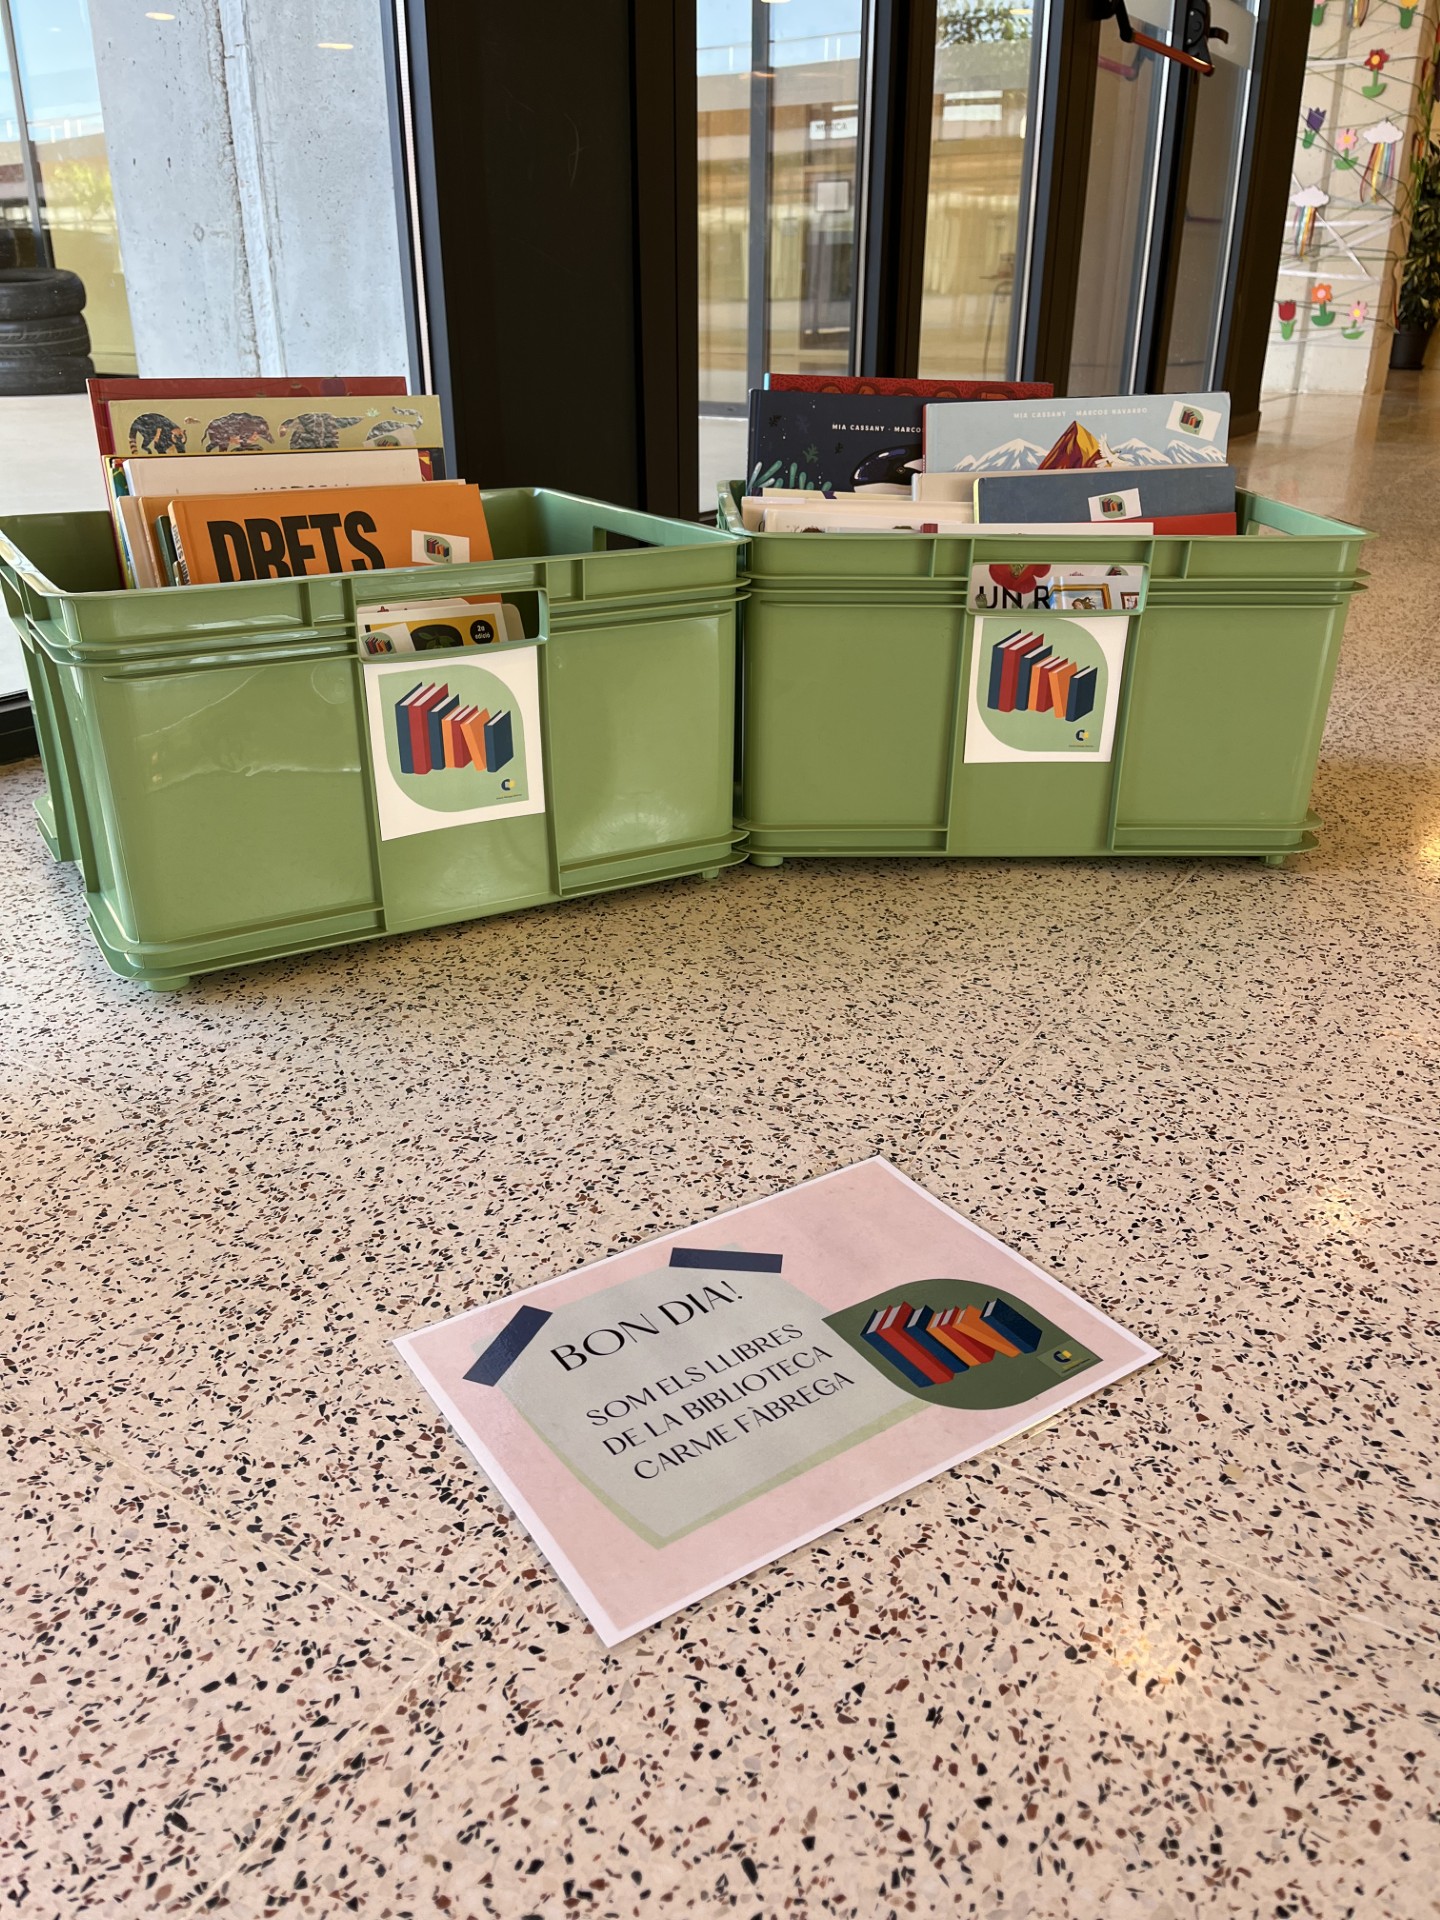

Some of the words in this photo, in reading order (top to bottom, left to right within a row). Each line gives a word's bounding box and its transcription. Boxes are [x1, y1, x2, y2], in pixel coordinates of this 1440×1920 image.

[831, 423, 847, 431] MIA
[849, 424, 885, 432] CASSANY
[1031, 410, 1066, 419] CASSANY
[1076, 409, 1108, 417] MARCOS
[1111, 407, 1148, 415] NAVARRO
[207, 511, 386, 583] DRETS
[550, 1313, 660, 1371] BON
[657, 1280, 743, 1326] DIA!
[586, 1387, 658, 1426] SOM
[655, 1366, 707, 1396] ELS
[704, 1324, 803, 1374] LLIBRES
[602, 1427, 647, 1456] DE
[643, 1412, 684, 1437] LA
[680, 1346, 834, 1420] BIBLIOTECA
[633, 1423, 738, 1479] CARME
[733, 1371, 855, 1433] FÀBREGA
